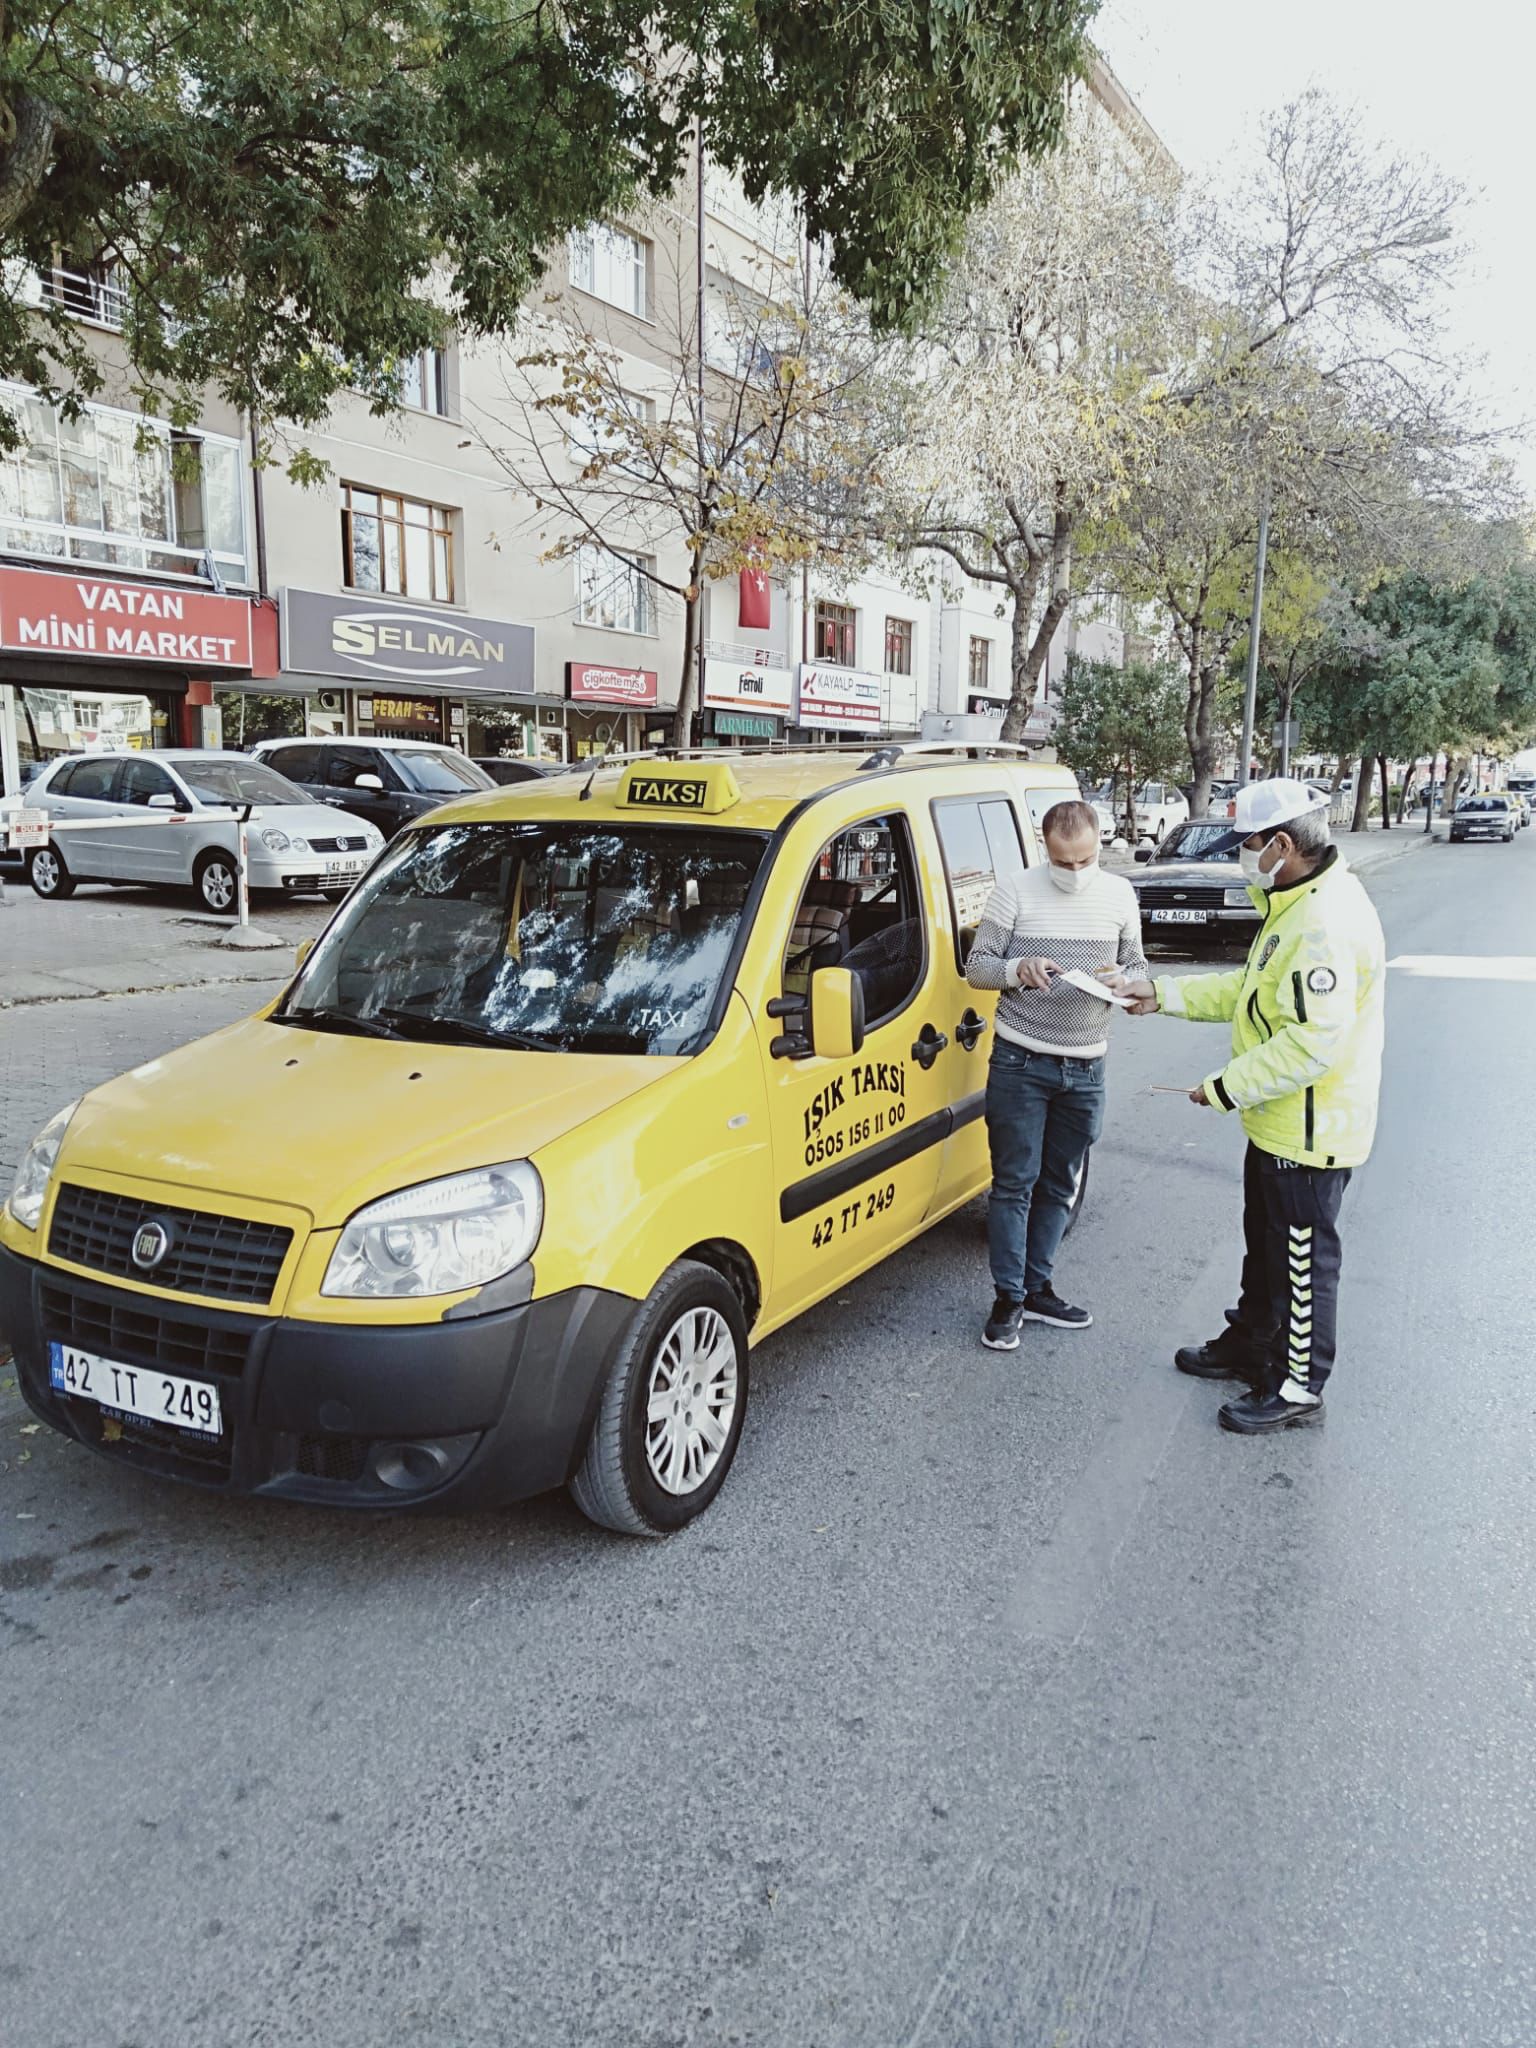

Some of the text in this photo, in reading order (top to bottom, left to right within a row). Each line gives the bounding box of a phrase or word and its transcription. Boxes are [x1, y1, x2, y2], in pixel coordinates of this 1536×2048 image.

[77, 584, 183, 619] VATAN
[18, 614, 236, 661] MİNİ MARKET
[332, 619, 504, 662] SELMAN
[738, 674, 764, 694] Ferroli
[373, 699, 412, 718] FERAH
[1156, 910, 1206, 920] 42 AGJ 84
[640, 1008, 688, 1028] TAXI
[804, 1102, 905, 1167] 0505 156 11 00
[812, 1183, 895, 1249] 42 TT 249
[65, 1354, 212, 1424] 42 TT 249
